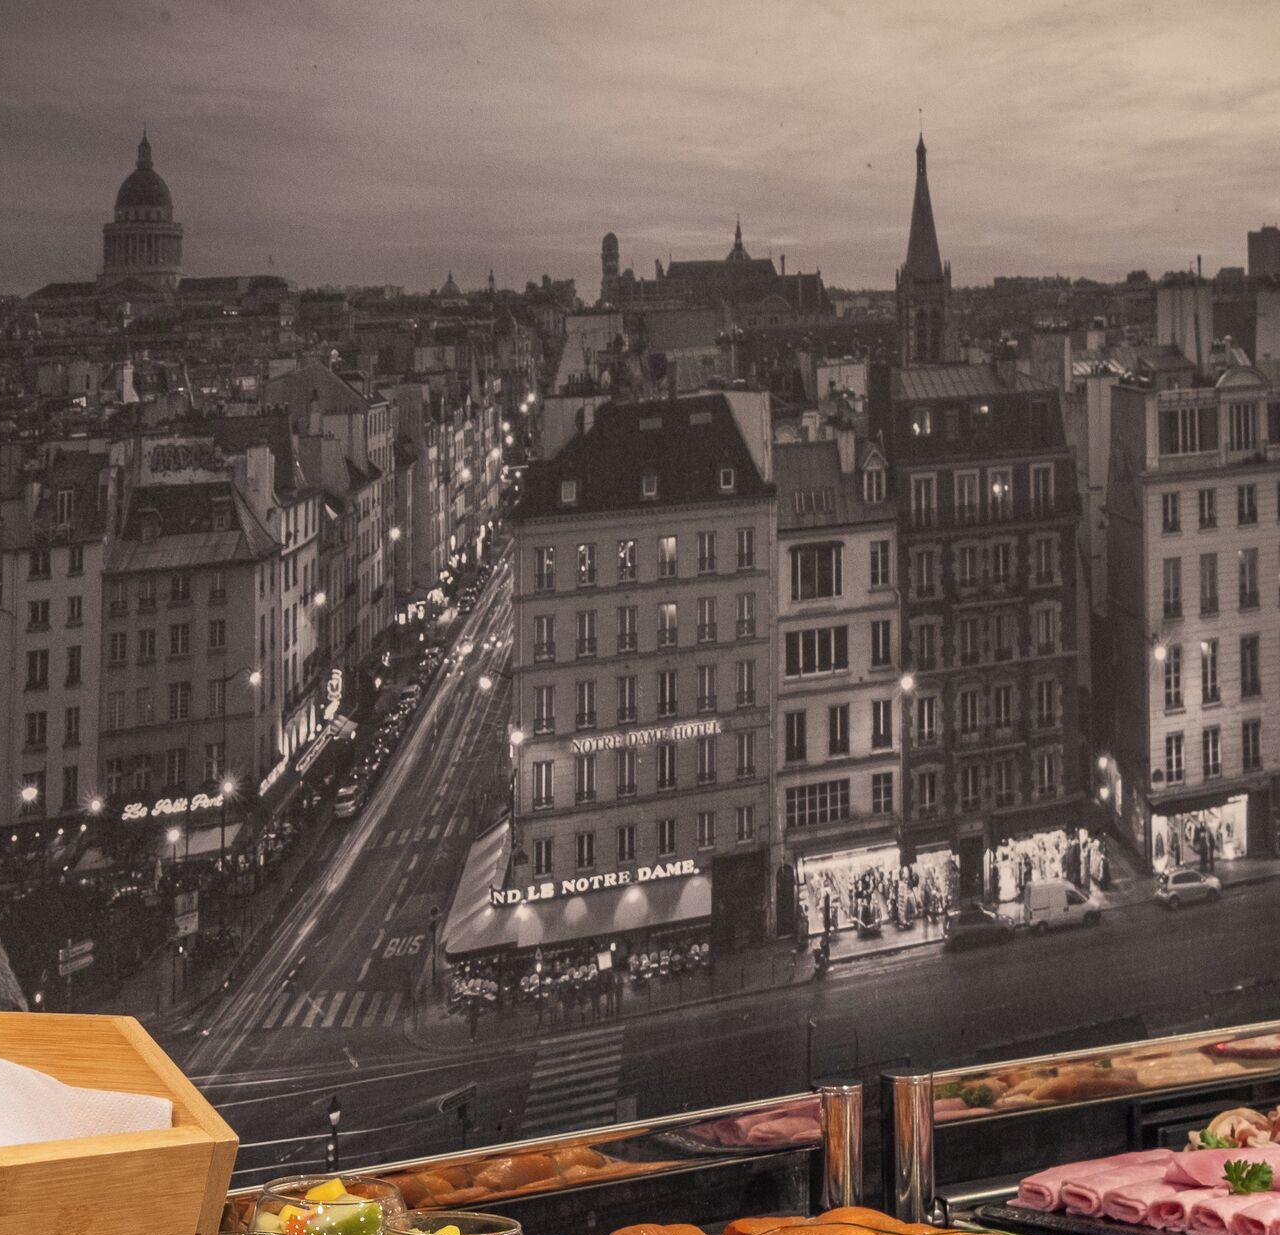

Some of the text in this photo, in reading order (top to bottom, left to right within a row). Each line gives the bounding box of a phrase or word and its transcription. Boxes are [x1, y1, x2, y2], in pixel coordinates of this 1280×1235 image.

[572, 719, 721, 754] NOTRE DAME HOTEL
[122, 802, 148, 820] Le
[190, 793, 224, 811] Pont
[562, 869, 631, 895] NOTRE
[382, 934, 425, 959] BUS
